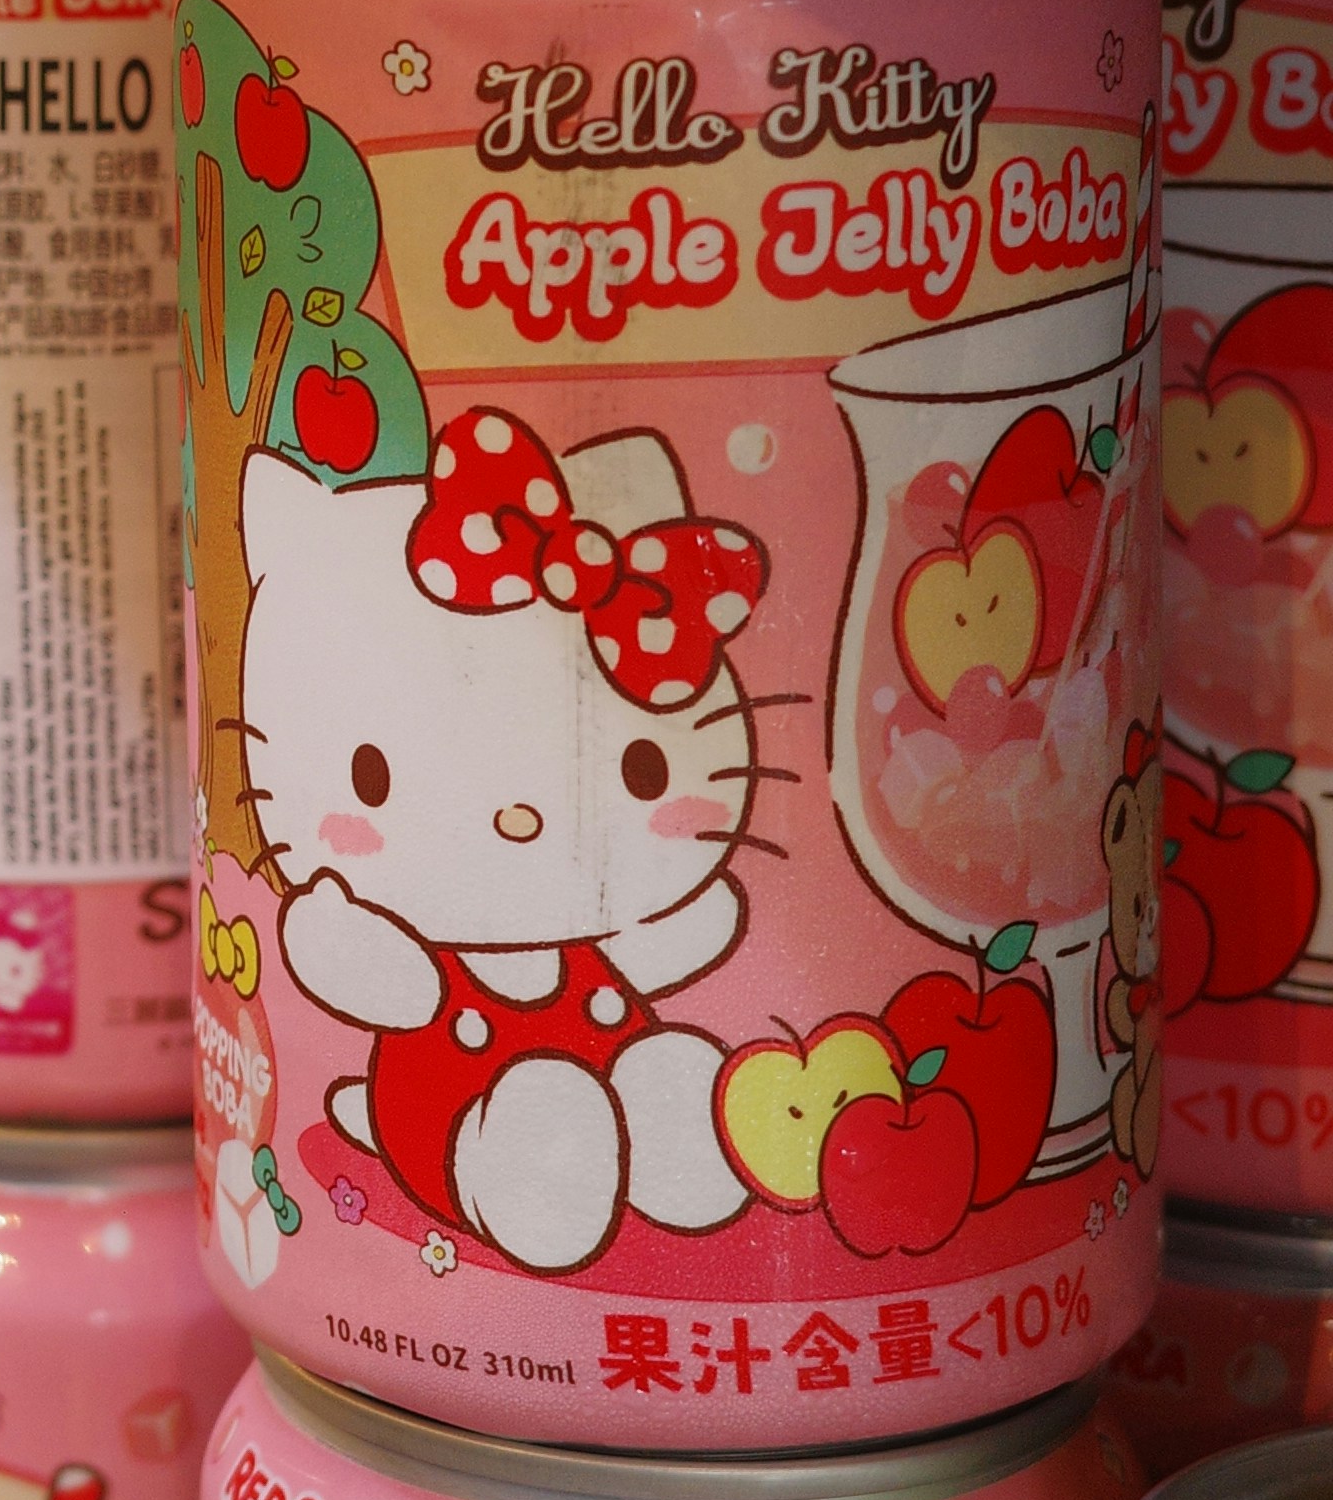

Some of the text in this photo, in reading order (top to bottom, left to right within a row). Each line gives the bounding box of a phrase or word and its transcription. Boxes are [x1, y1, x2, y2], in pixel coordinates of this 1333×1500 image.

[479, 46, 994, 186] Hello Kitty
[451, 148, 1126, 336] Apple Jelly Boba
[140, 879, 190, 943] S
[202, 1058, 255, 1139] BOBA
[323, 1313, 577, 1388] 10.48 FL OZ 310ml
[597, 1266, 1093, 1397] 果汁含量<10%
